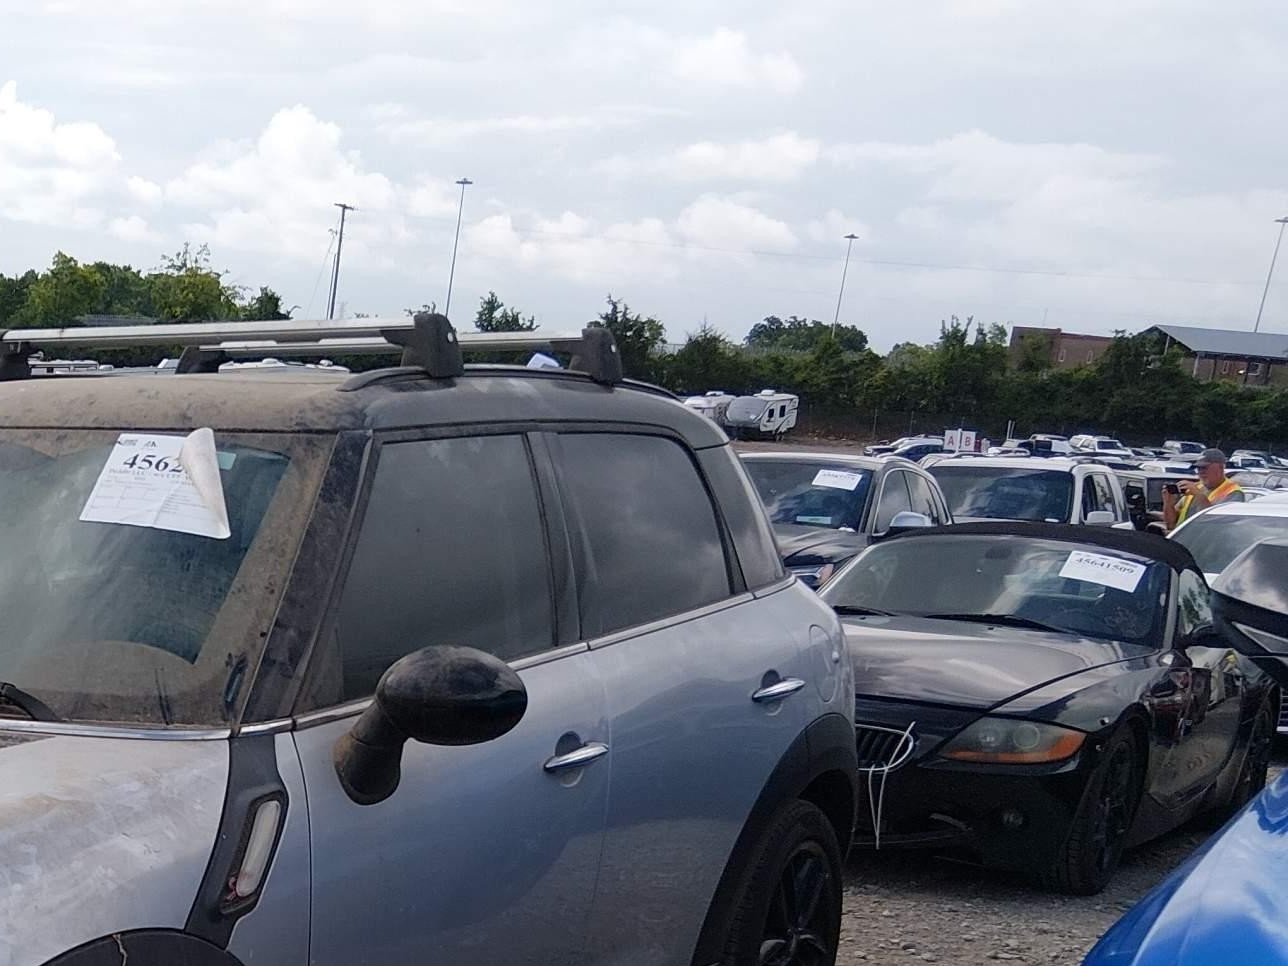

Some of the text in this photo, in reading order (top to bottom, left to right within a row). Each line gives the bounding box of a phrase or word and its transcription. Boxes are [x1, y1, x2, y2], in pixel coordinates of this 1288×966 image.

[946, 436, 955, 446] A
[964, 436, 972, 447] B
[123, 453, 186, 473] 4562
